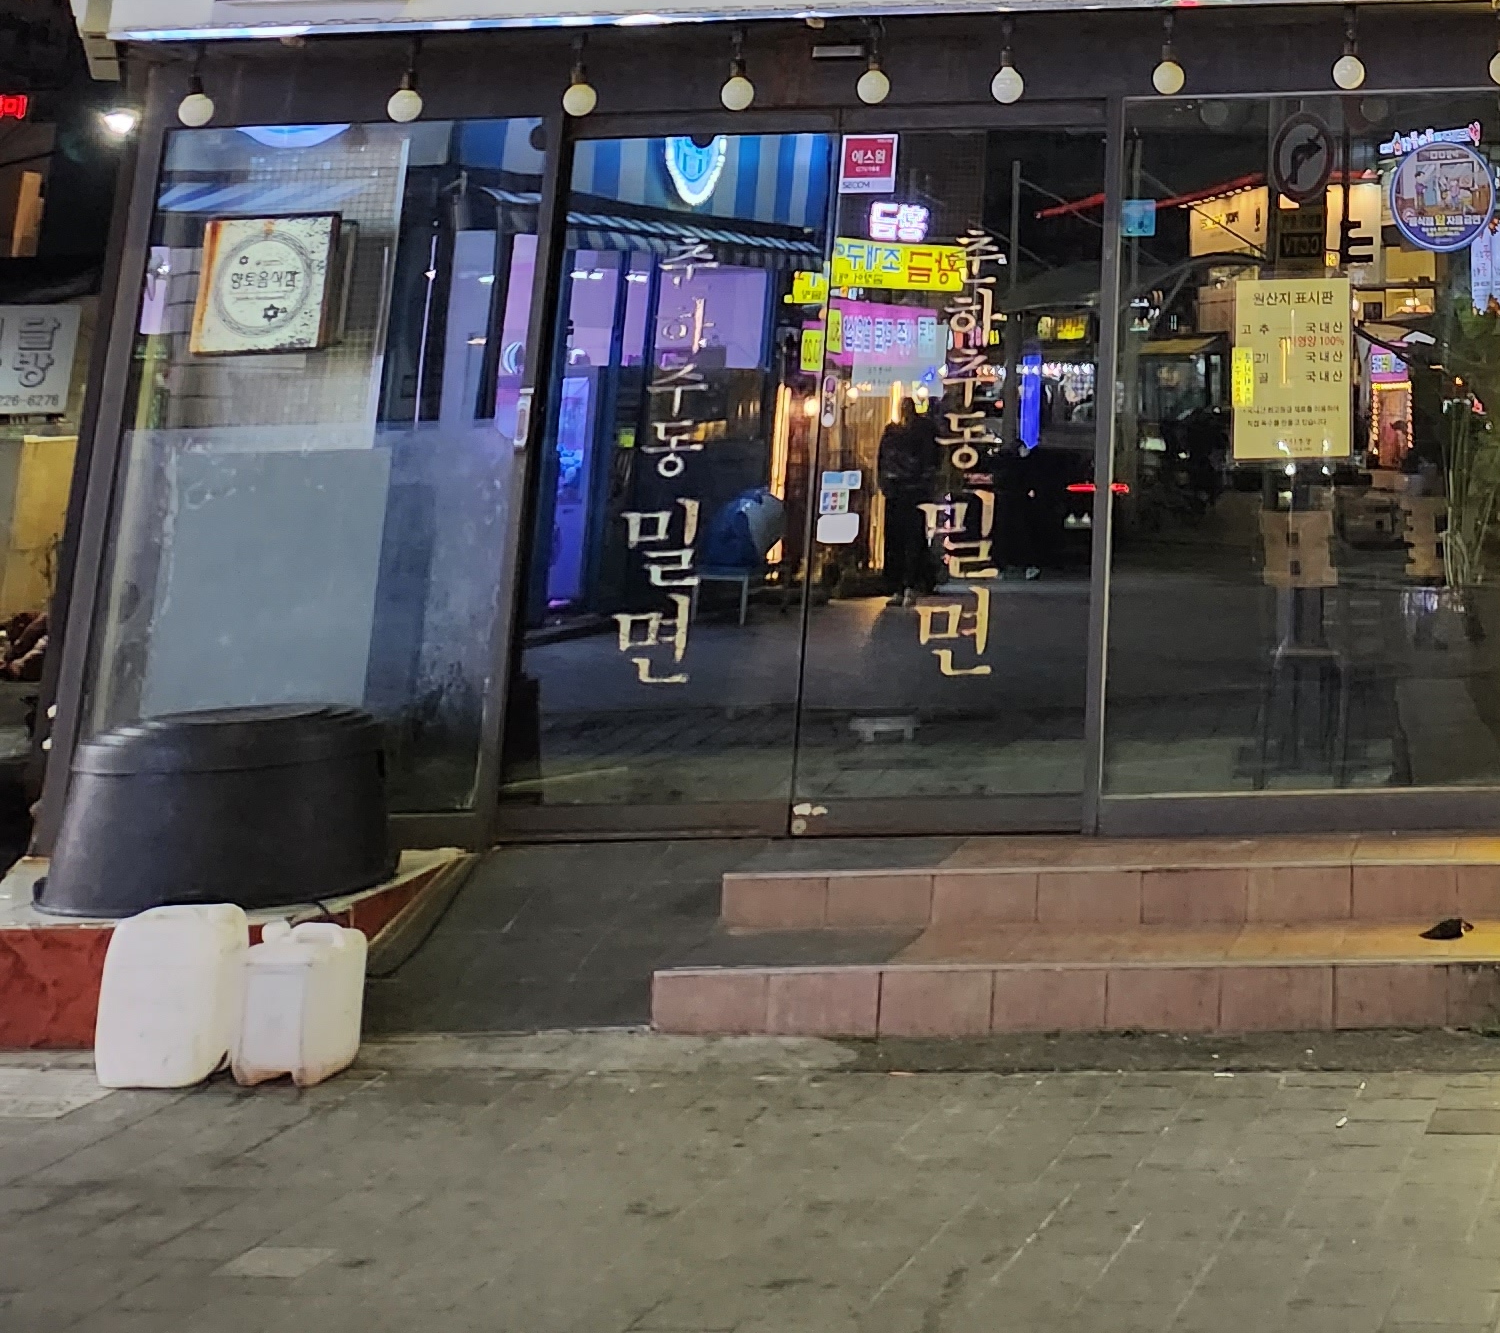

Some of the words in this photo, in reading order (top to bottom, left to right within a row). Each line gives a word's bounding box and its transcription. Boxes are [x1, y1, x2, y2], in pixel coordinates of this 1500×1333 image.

[1253, 290, 1292, 306] 원산지
[1295, 290, 1334, 306] 표시판
[612, 497, 700, 685] 밀면
[915, 489, 999, 677] 밀면
